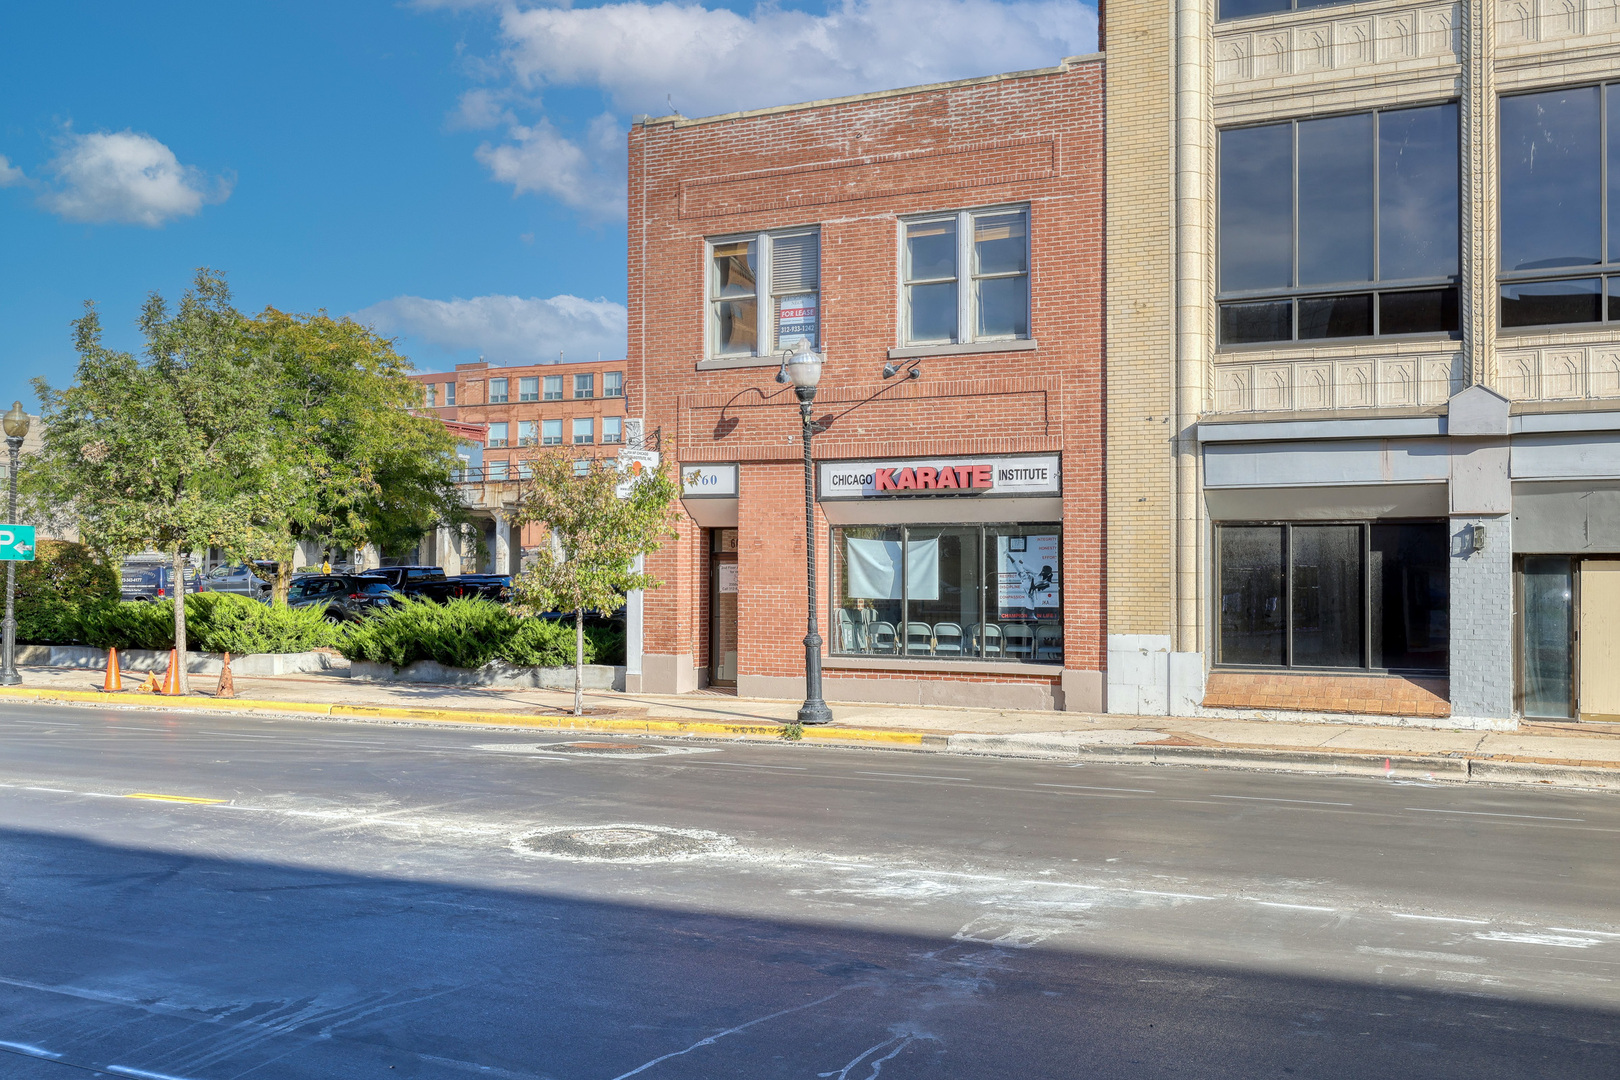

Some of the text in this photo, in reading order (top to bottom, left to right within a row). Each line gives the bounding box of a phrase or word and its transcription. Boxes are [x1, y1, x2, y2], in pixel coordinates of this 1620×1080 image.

[701, 474, 718, 486] 60
[832, 464, 1048, 491] CHICAGO KARATE INSTITUTE
